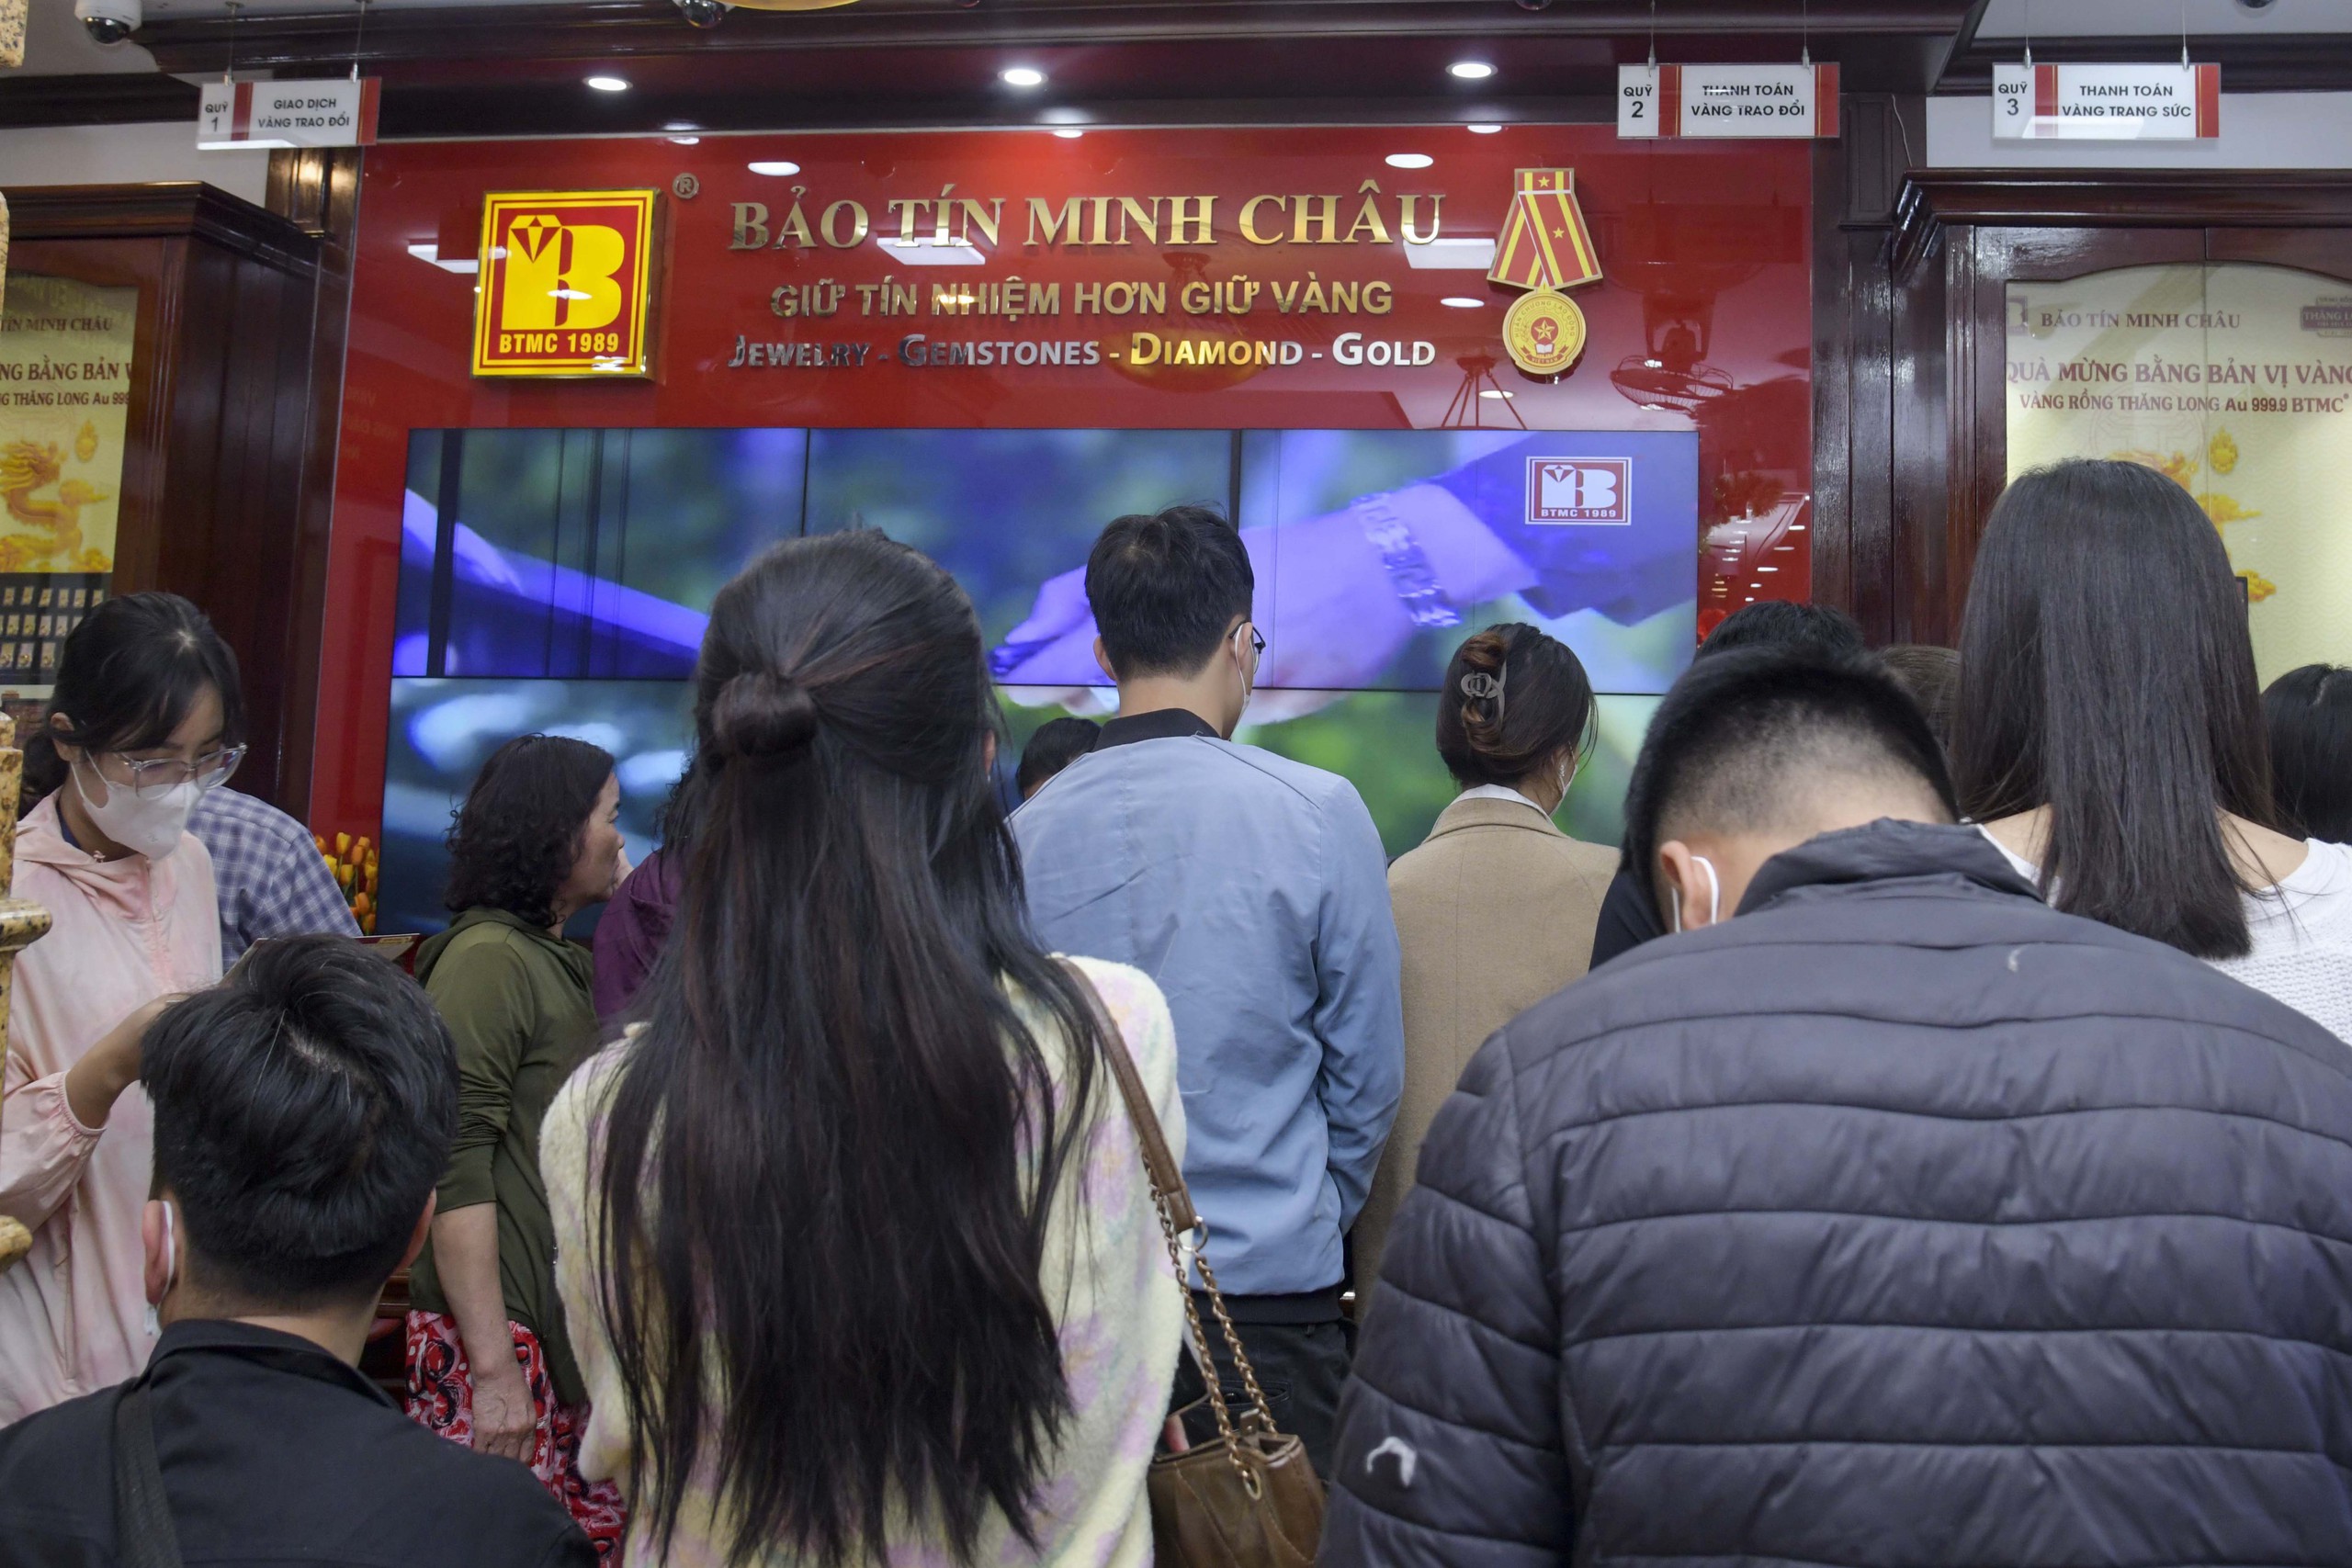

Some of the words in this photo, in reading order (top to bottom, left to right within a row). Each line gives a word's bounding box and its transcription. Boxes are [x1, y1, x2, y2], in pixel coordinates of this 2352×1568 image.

[1623, 84, 1653, 96] QUỸ
[1702, 85, 1750, 96] THANH
[1755, 83, 1793, 96] TOÁN
[1997, 81, 2028, 94] QUỸ
[2079, 85, 2129, 96] THANH
[2133, 83, 2173, 96] TOÁN
[205, 101, 229, 113] QUỸ
[274, 98, 304, 109] GIAO
[307, 97, 337, 111] DỊCH
[1631, 101, 1644, 118] 2
[1691, 103, 1733, 116] VÀNG
[1737, 105, 1774, 116] TRAO
[1779, 99, 1804, 116] ĐỔI
[2007, 98, 2019, 116] 3
[2062, 103, 2105, 117] VÀNG
[2109, 106, 2157, 117] TRANG
[2162, 103, 2191, 117] SỨC
[211, 117, 219, 132] 1
[258, 116, 291, 128] VÀNG
[295, 117, 324, 128] TRAO
[328, 110, 350, 127] ĐỔI
[728, 186, 869, 251] BẢO
[888, 183, 1006, 248] TÍN
[1023, 195, 1218, 246] MINH
[1238, 179, 1446, 245] CHÂU
[771, 277, 845, 318] GIỮ
[855, 275, 917, 317] TÍN
[932, 276, 1060, 321] NHIỆM
[1074, 281, 1166, 315] HƠN
[1181, 275, 1260, 315] GIỮ
[1272, 271, 1393, 315] VÀNG
[26, 318, 66, 332] MINH
[70, 316, 112, 332] CHÂU
[2041, 309, 2081, 327] BẢO
[2086, 310, 2119, 327] TÍN
[2126, 313, 2179, 328] MINH
[2185, 310, 2240, 328] CHÂU
[499, 333, 559, 354] BTMC
[568, 333, 619, 353] 1989
[728, 333, 870, 367] JEWELRY
[898, 333, 1100, 367] GEMSTONES
[1130, 332, 1303, 366] DIAMOND
[1332, 332, 1436, 367] GOLD
[28, 355, 77, 380] BẰNG
[83, 355, 119, 380] BẢN
[2007, 356, 2051, 383] QUÀ
[2058, 356, 2128, 382] MỪNG
[2135, 354, 2200, 383] BẰNG
[2207, 357, 2256, 384] BẢN
[2264, 365, 2288, 388] VỊ
[14, 390, 53, 405] THĂNG
[57, 392, 89, 405] LONG
[93, 392, 109, 405] Au
[2019, 390, 2064, 409] VÀNG
[2068, 388, 2113, 410] RỒNG
[2118, 392, 2173, 411] THĂNG
[2177, 397, 2220, 411] LONG
[2225, 398, 2247, 412] Au
[2252, 397, 2288, 412] 999.9
[1541, 509, 1578, 517] BTMC
[1584, 509, 1617, 517] 1989
